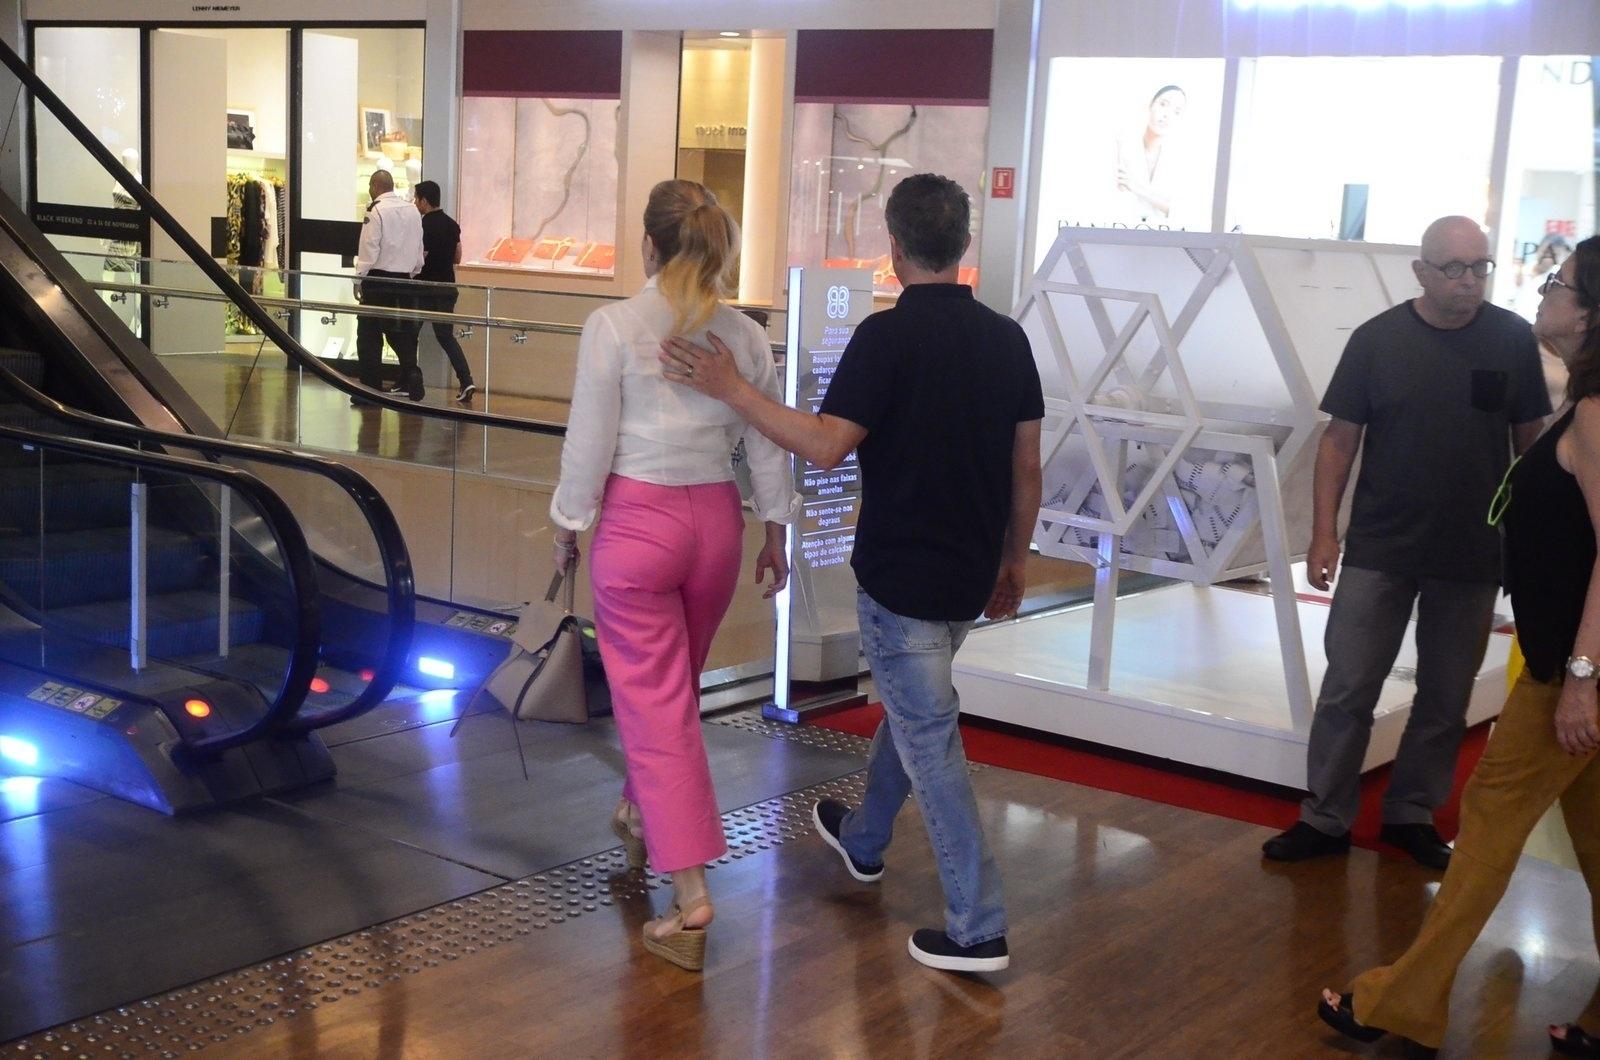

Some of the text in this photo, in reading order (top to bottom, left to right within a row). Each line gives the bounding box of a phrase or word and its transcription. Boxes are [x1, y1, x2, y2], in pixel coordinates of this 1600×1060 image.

[804, 479, 816, 487] Não
[816, 477, 829, 487] pise
[840, 473, 857, 482] faixas
[817, 485, 842, 495] amarelas
[805, 509, 817, 517] Não
[818, 507, 842, 515] sente-se
[818, 517, 840, 527] degraus
[801, 538, 824, 549] Atenção
[824, 537, 837, 546] com
[804, 550, 819, 560] tipos
[819, 548, 828, 556] de
[811, 555, 845, 568] de borracha
